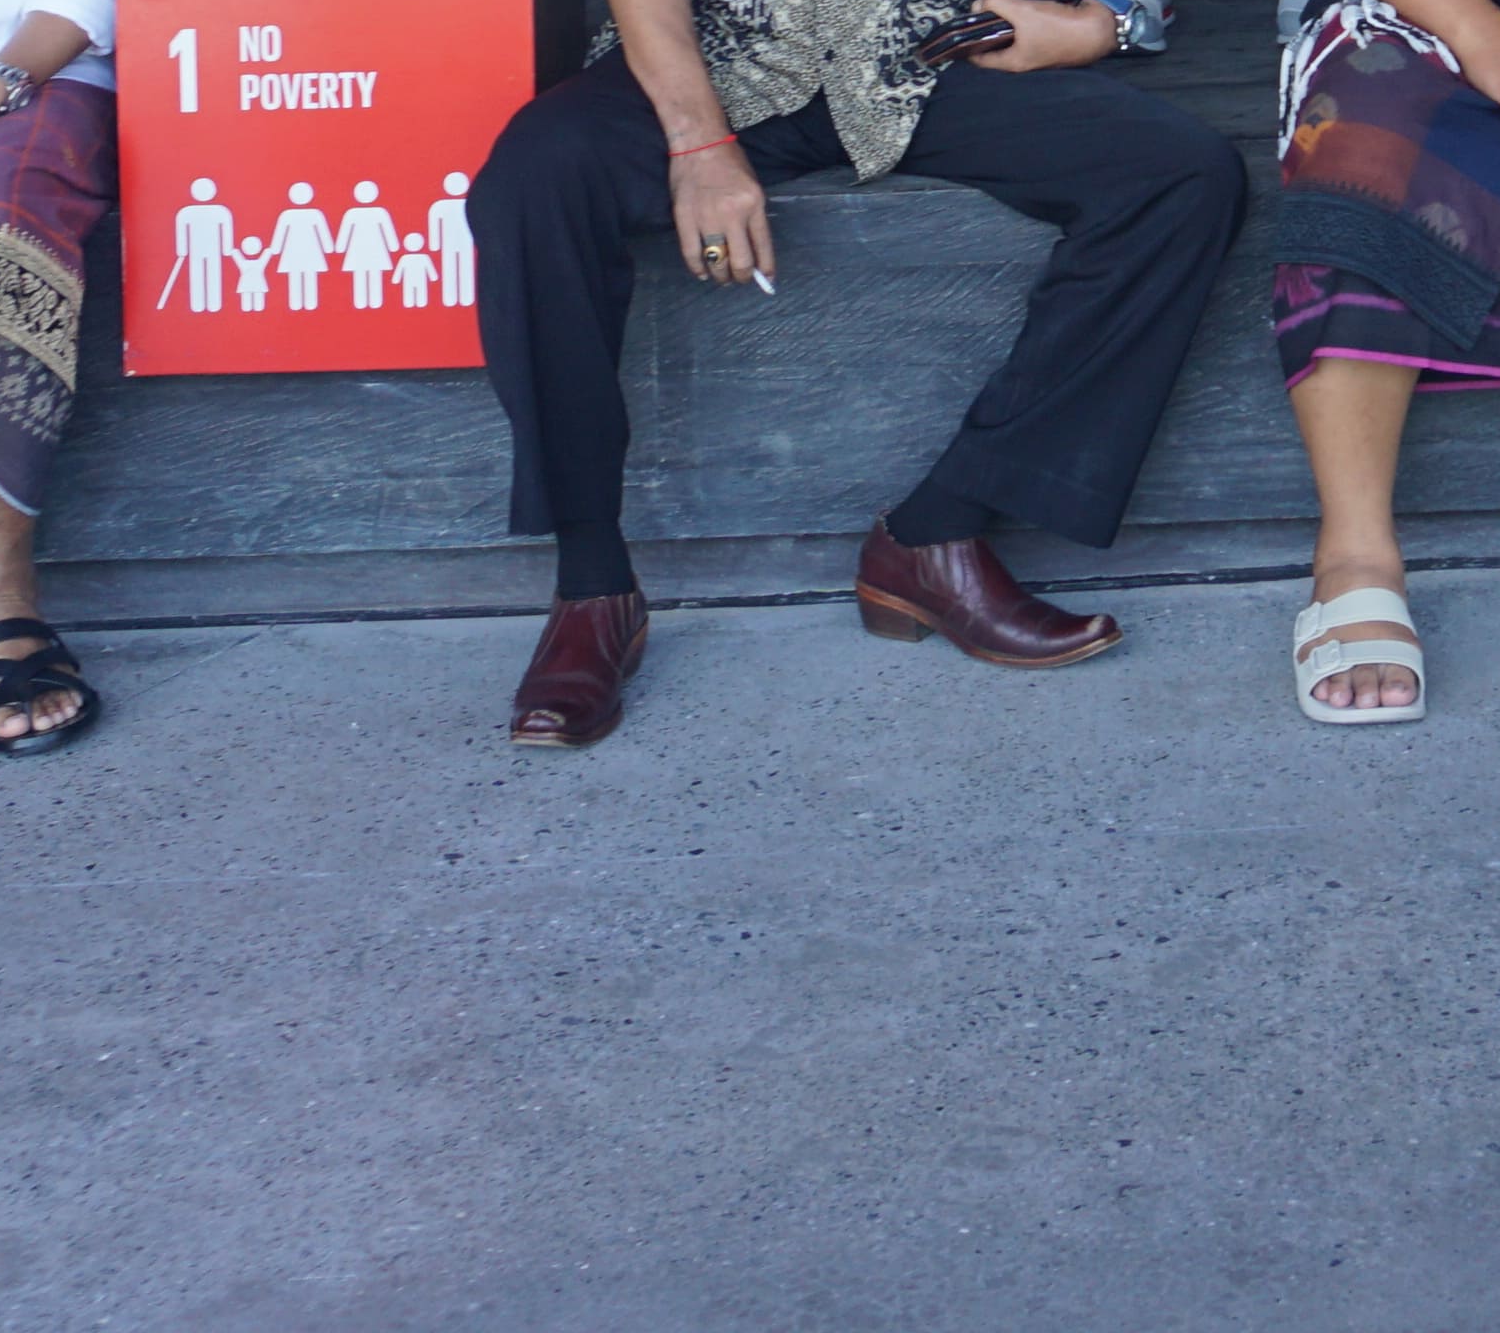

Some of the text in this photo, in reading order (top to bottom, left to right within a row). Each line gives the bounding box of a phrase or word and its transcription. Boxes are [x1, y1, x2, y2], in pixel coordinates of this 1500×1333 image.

[238, 25, 282, 62] NO
[169, 28, 198, 113] 1
[239, 71, 377, 111] POVERTY
